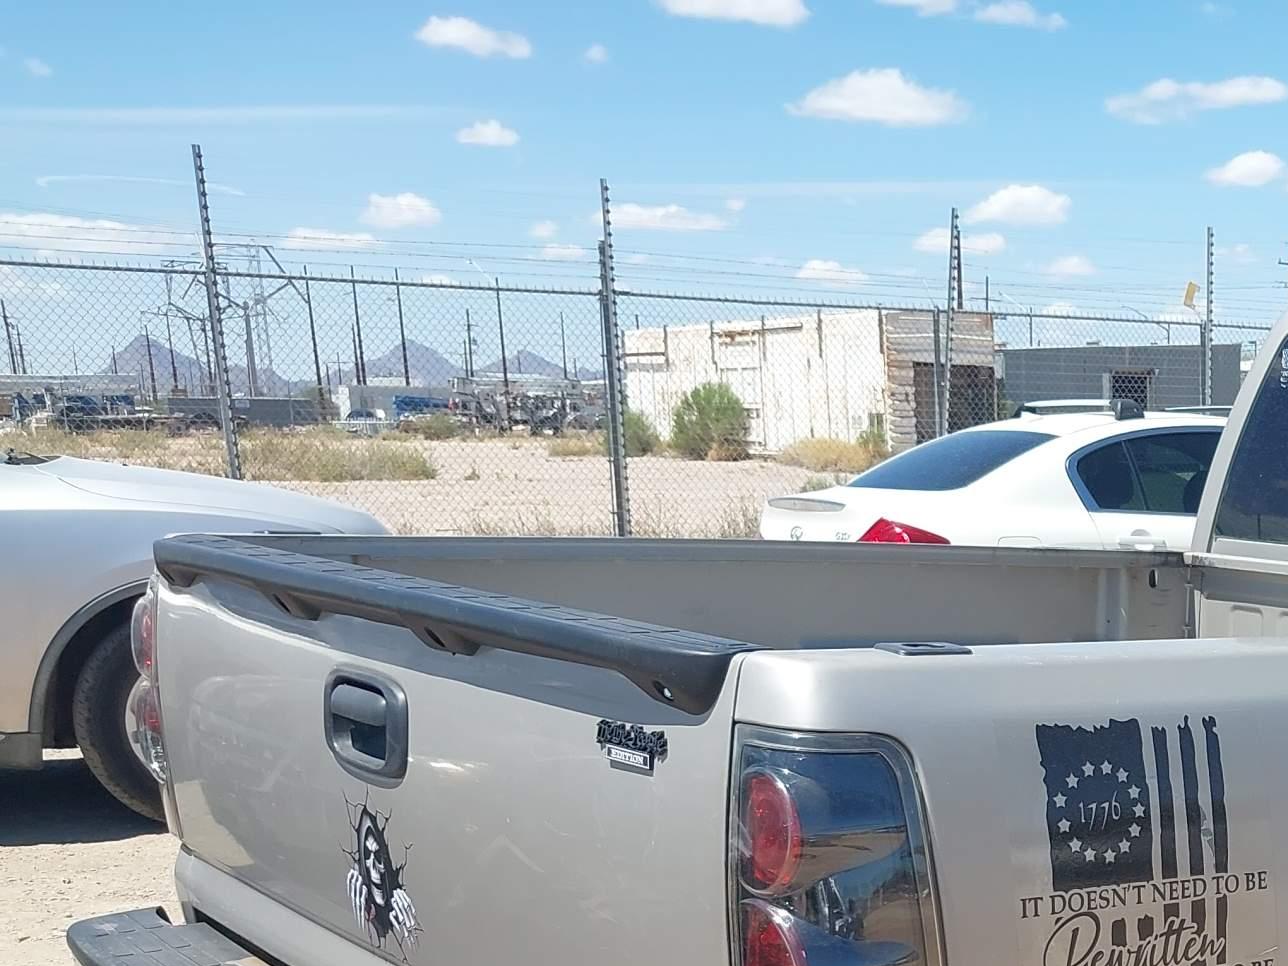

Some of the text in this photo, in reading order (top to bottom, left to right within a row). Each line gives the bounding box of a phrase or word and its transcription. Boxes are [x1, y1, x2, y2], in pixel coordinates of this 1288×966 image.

[610, 748, 644, 766] EDITION
[1078, 790, 1121, 830] 1776
[1020, 871, 1268, 918] IT DOESN'T NEED TO BE
